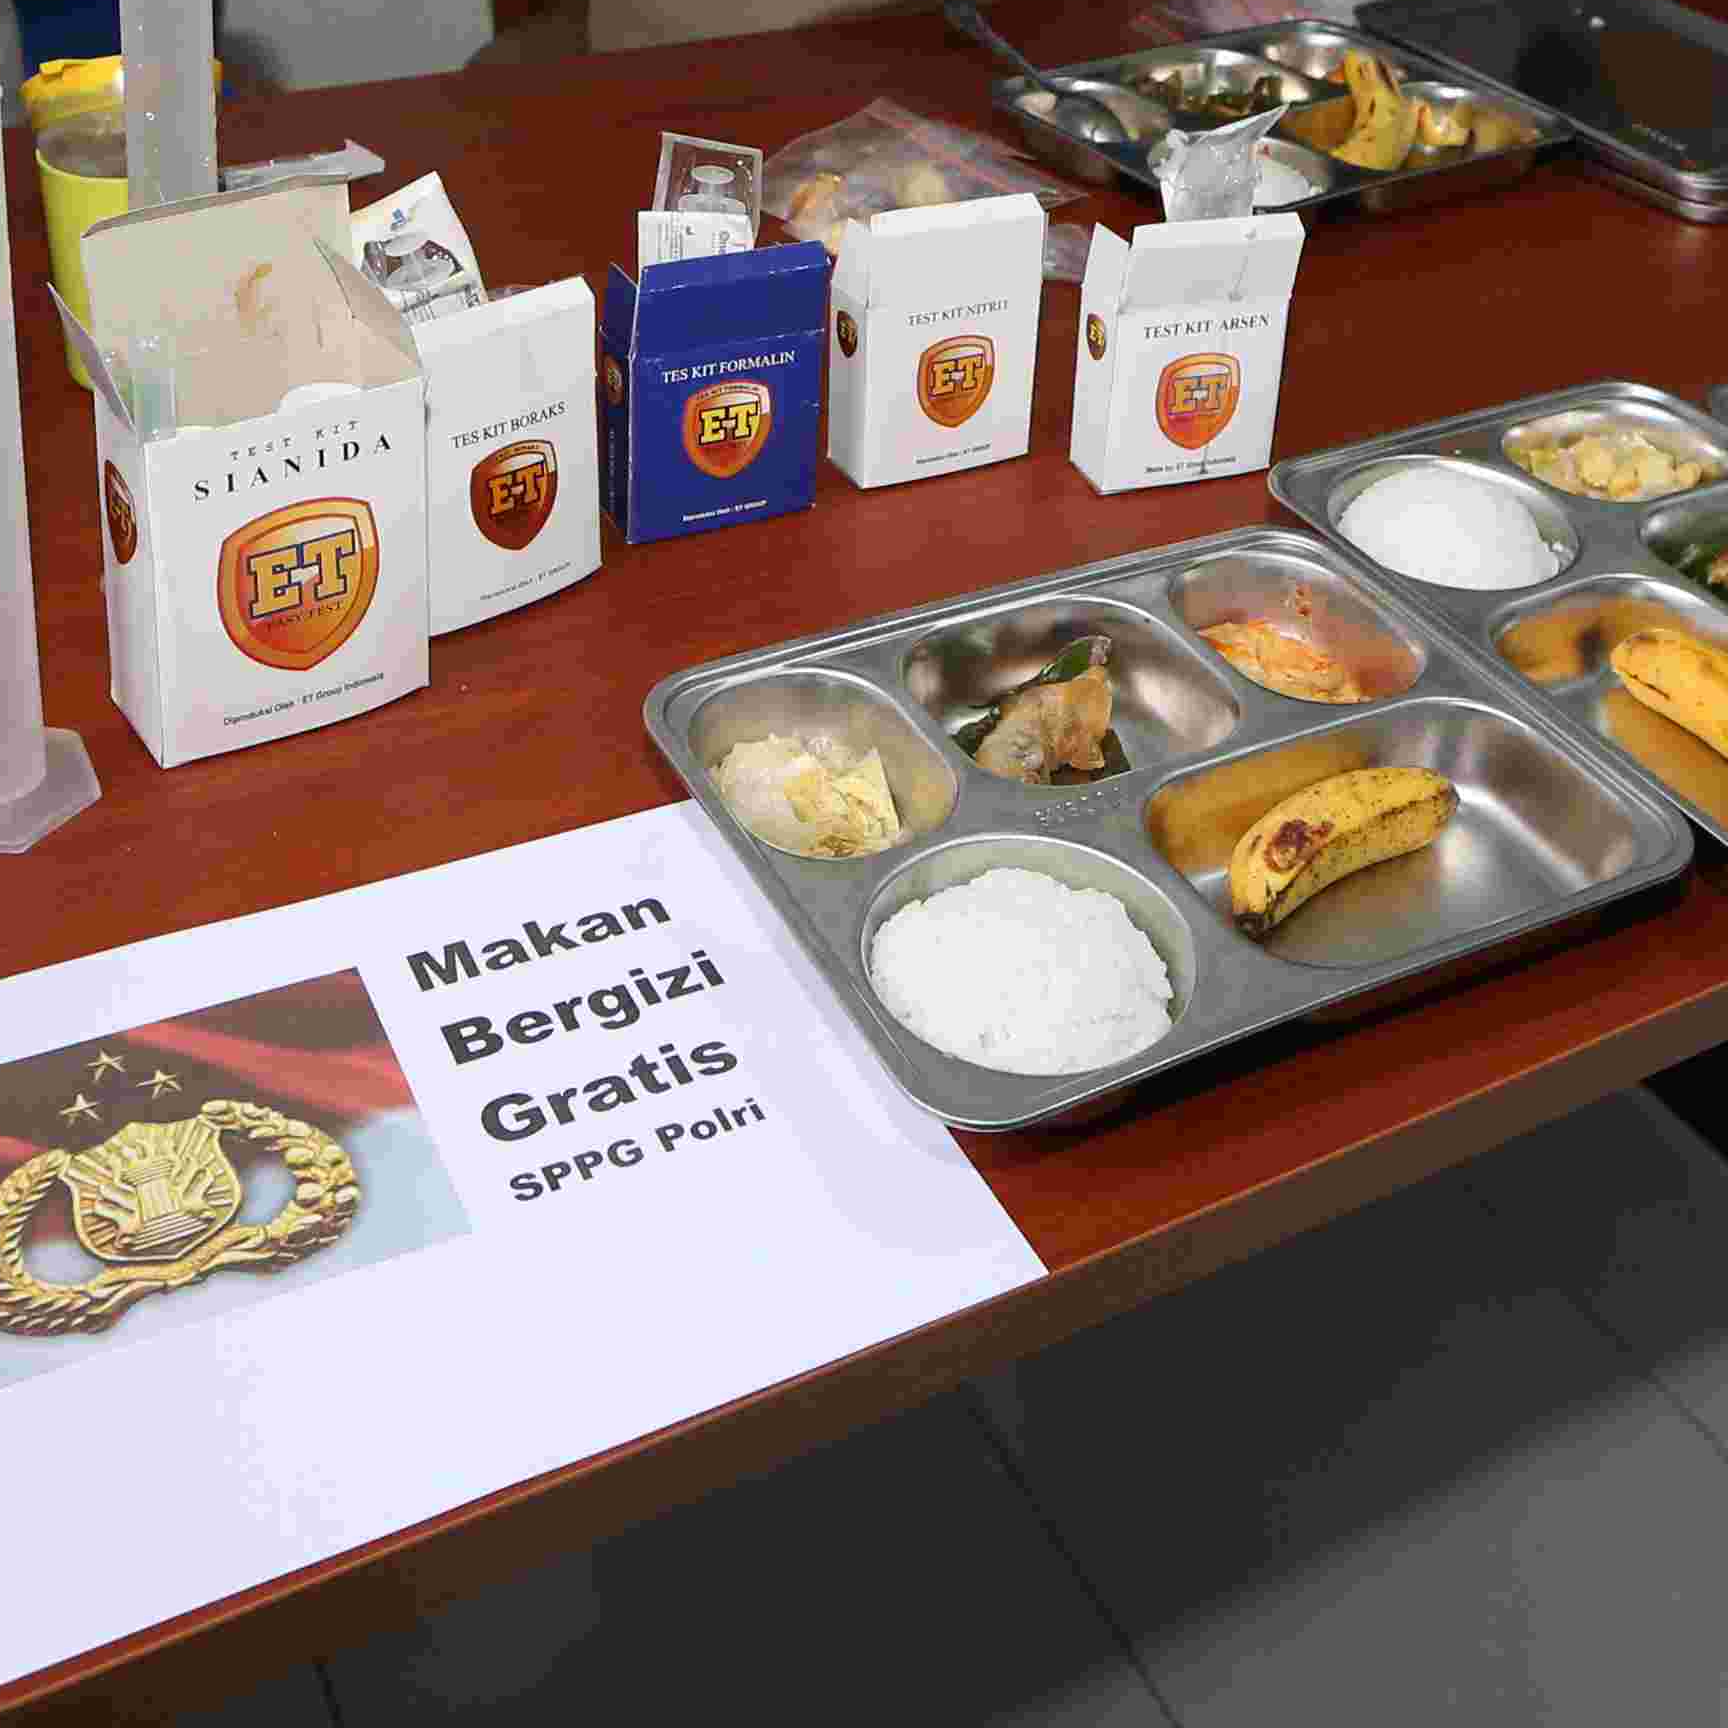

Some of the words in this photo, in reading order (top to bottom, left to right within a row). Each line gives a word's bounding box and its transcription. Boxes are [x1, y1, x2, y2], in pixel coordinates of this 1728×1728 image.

[907, 311, 939, 327] TEST
[941, 307, 963, 321] KIT
[1144, 323, 1180, 340] TEST
[1184, 319, 1213, 335] KIT
[1219, 312, 1271, 331] ARSEN
[662, 367, 688, 384] TES
[692, 362, 717, 379] KIT
[718, 350, 796, 373] FORMALIN
[229, 436, 292, 461] TEST
[315, 419, 360, 440] KIT
[451, 432, 480, 449] TES
[482, 421, 508, 441] KIT
[510, 400, 566, 432] BORAKS
[193, 433, 392, 502] SIANIDA
[405, 896, 672, 993] Makan
[440, 949, 726, 1066] Bergizi
[480, 1041, 739, 1143] Gratis
[508, 1138, 646, 1202] SPPG
[655, 1097, 767, 1153] Polri
